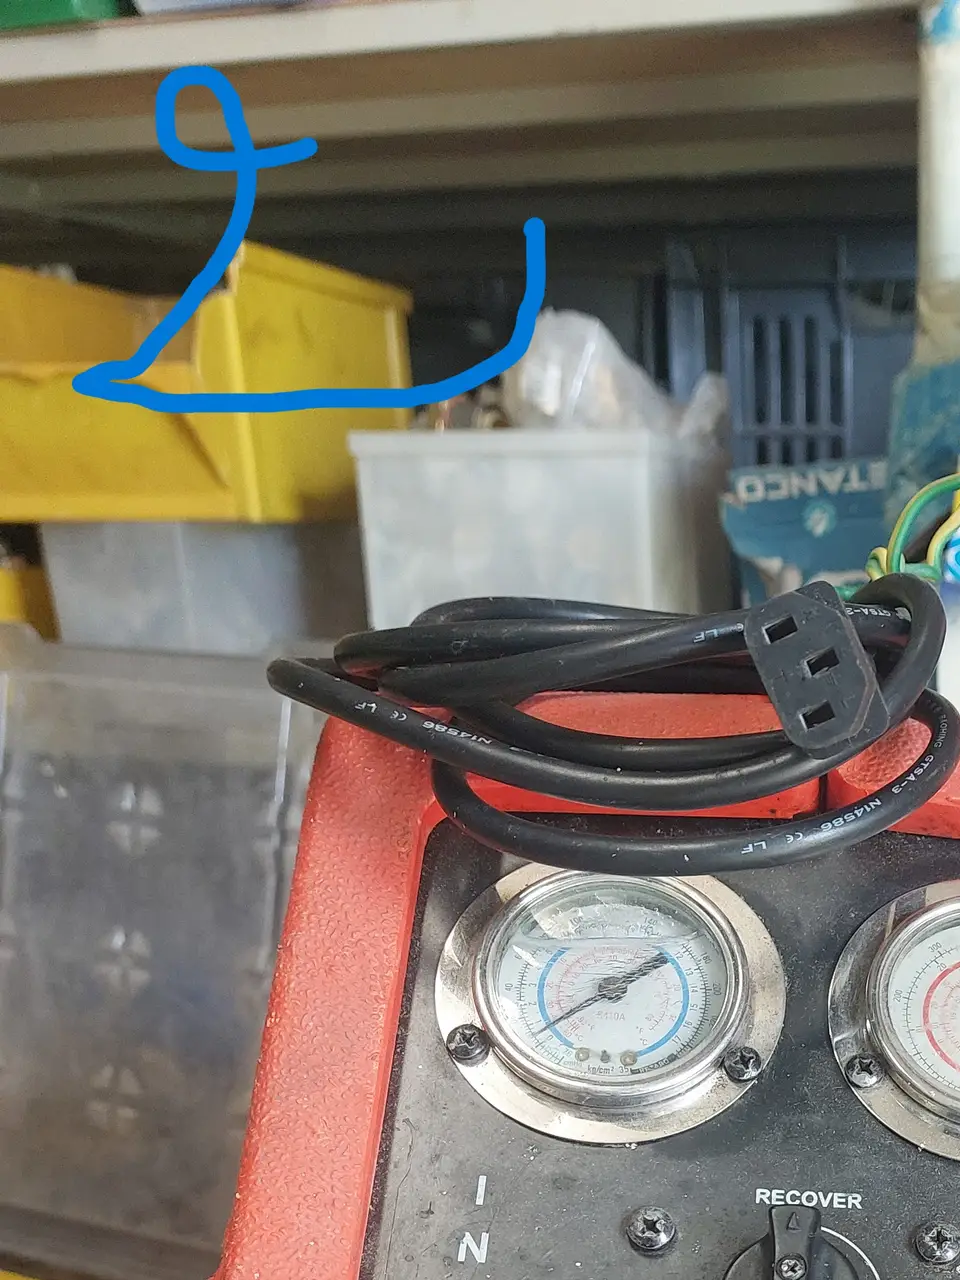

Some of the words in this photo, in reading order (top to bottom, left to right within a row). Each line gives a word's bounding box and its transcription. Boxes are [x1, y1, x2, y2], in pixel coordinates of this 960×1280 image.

[354, 701, 378, 714] LF
[421, 720, 492, 745] N14586
[820, 797, 882, 832] N14586
[741, 840, 768, 854] LF
[927, 941, 942, 953] 300
[893, 989, 903, 1003] 200
[755, 1187, 863, 1210] RECOVER
